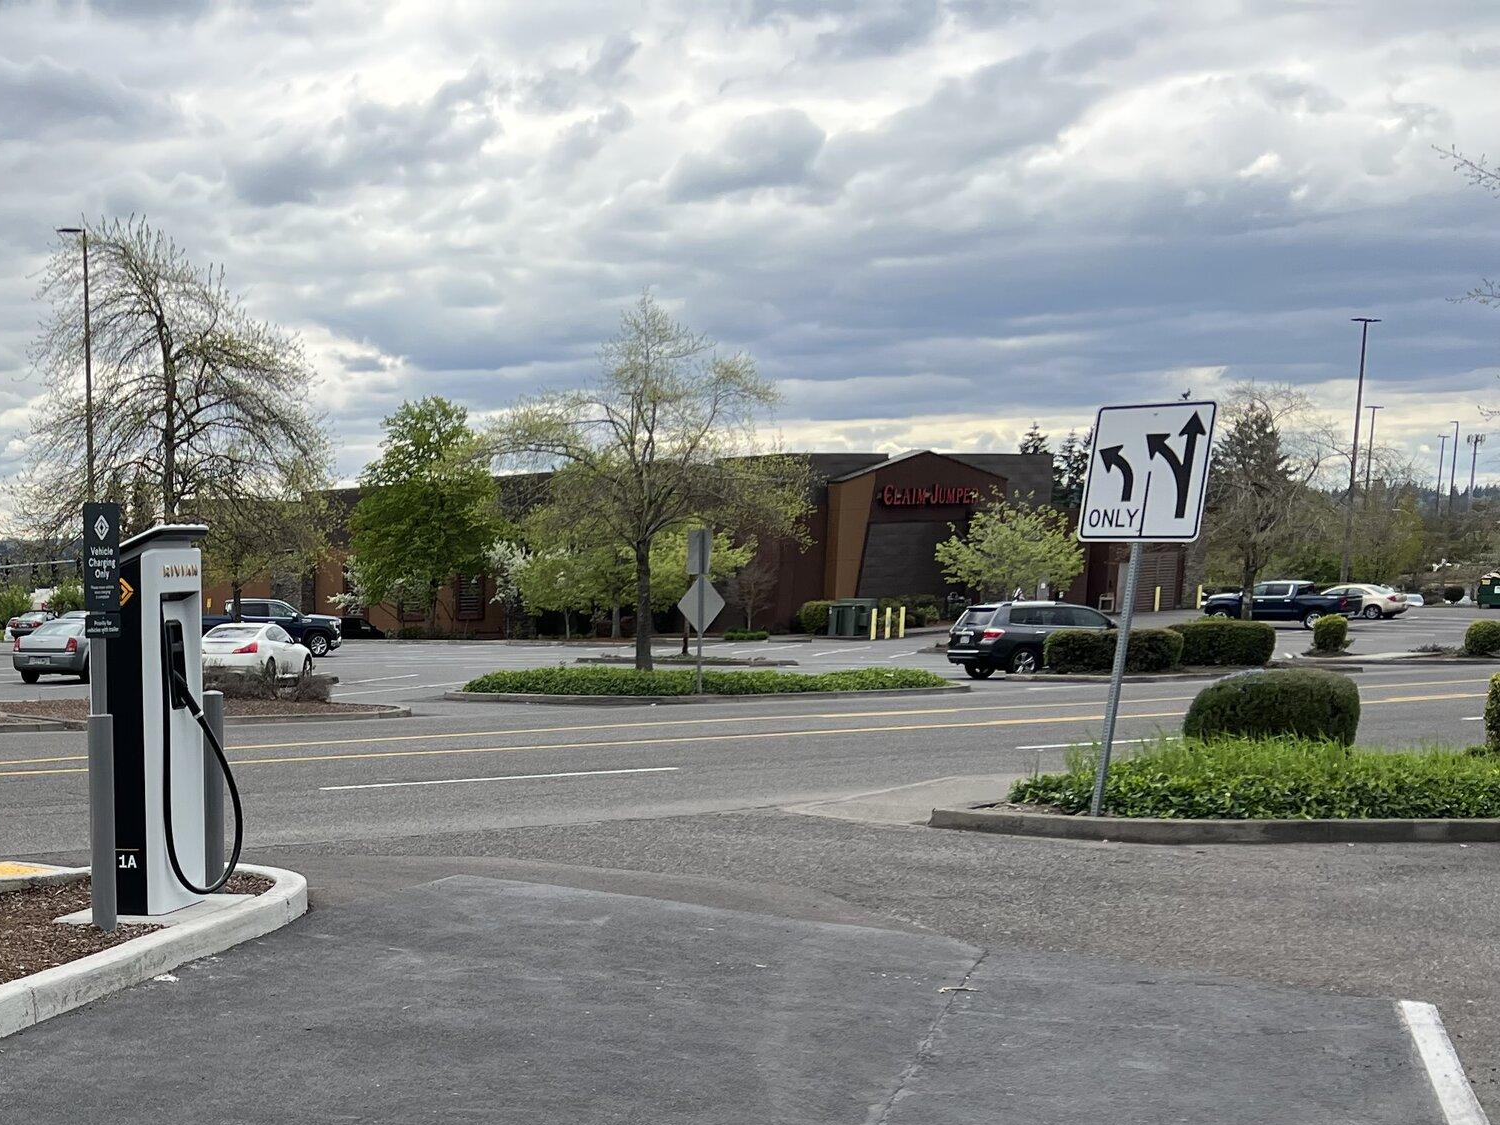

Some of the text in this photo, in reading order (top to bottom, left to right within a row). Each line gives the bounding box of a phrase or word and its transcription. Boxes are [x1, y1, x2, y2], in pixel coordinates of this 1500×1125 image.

[883, 485, 927, 505] CLAIM
[1089, 508, 1140, 528] ONLY
[90, 547, 113, 556] Vehicle
[88, 558, 116, 569] Charging
[94, 569, 110, 580] Only
[162, 564, 197, 577] RIVIAN
[119, 854, 137, 868] 1A
